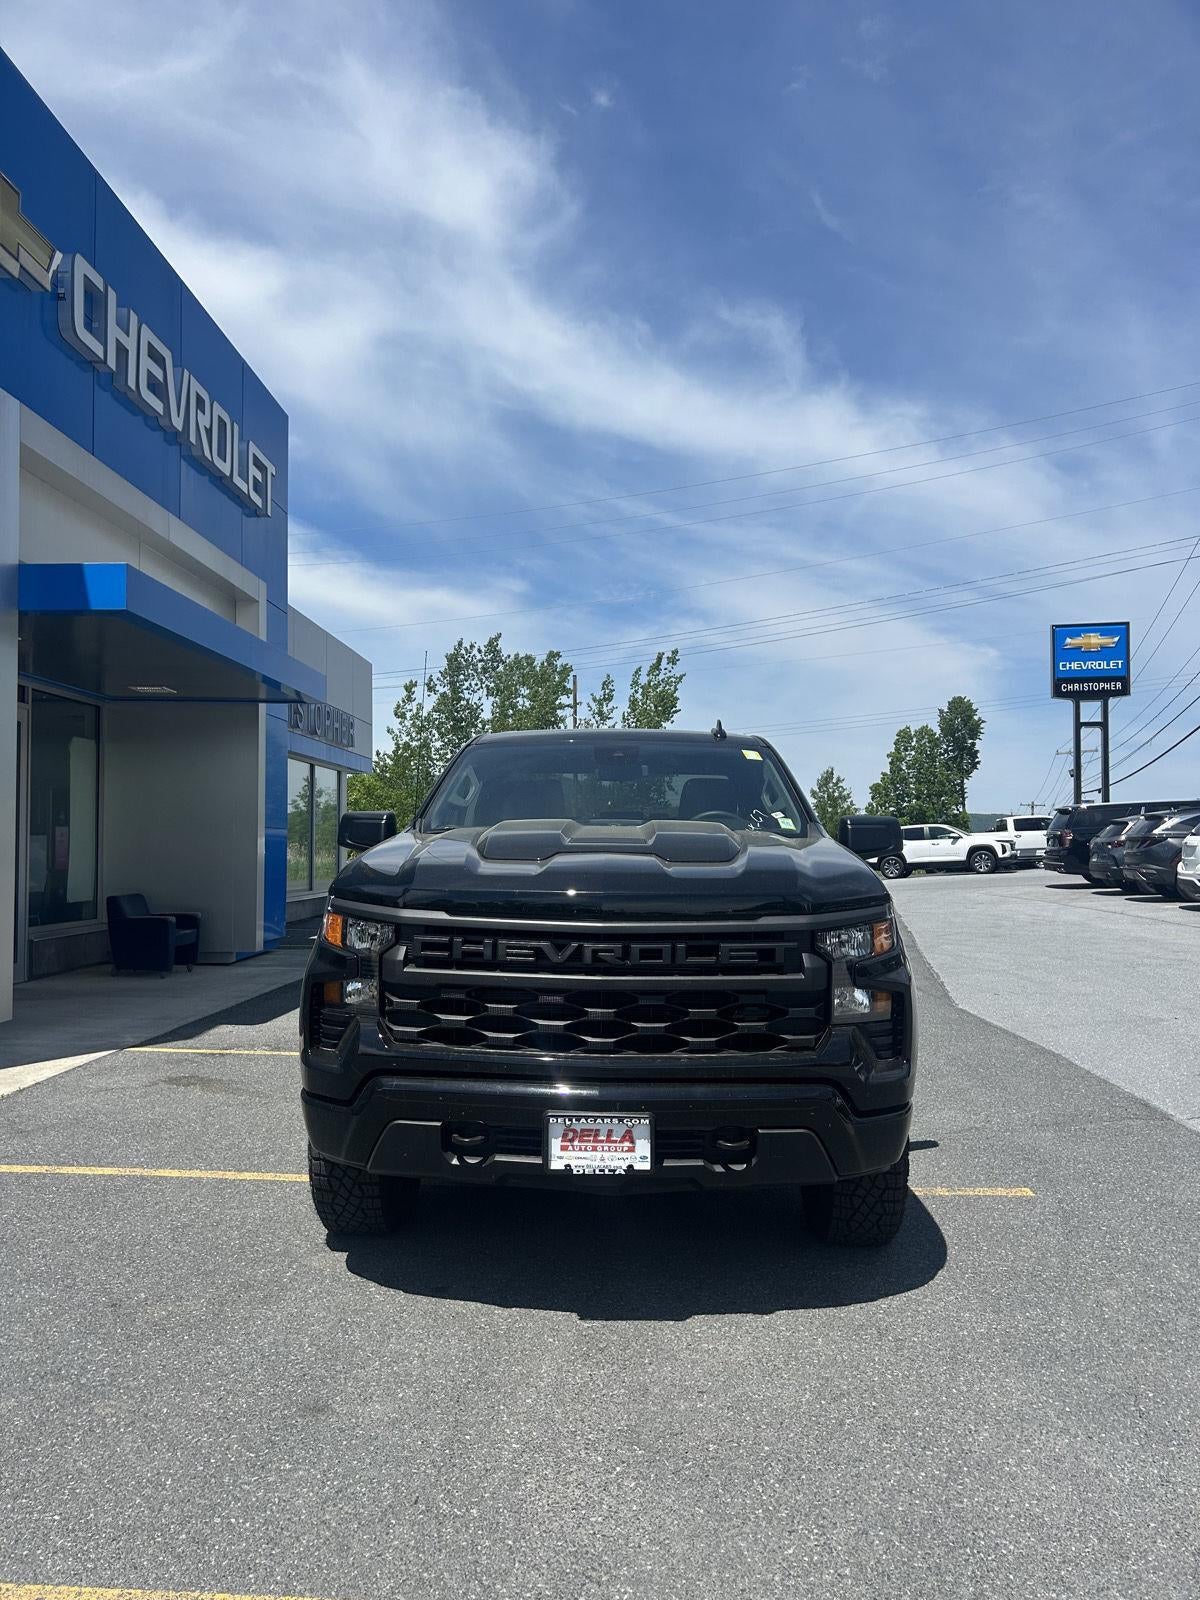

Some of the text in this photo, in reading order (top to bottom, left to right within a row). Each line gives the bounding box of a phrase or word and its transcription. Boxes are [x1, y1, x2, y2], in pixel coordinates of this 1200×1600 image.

[64, 252, 277, 518] CHEVROLET
[1060, 661, 1123, 670] CHEVROLET
[1062, 682, 1122, 691] CHRISTOPHER
[413, 934, 799, 966] CHEVROLET
[561, 1128, 635, 1143] DELLA
